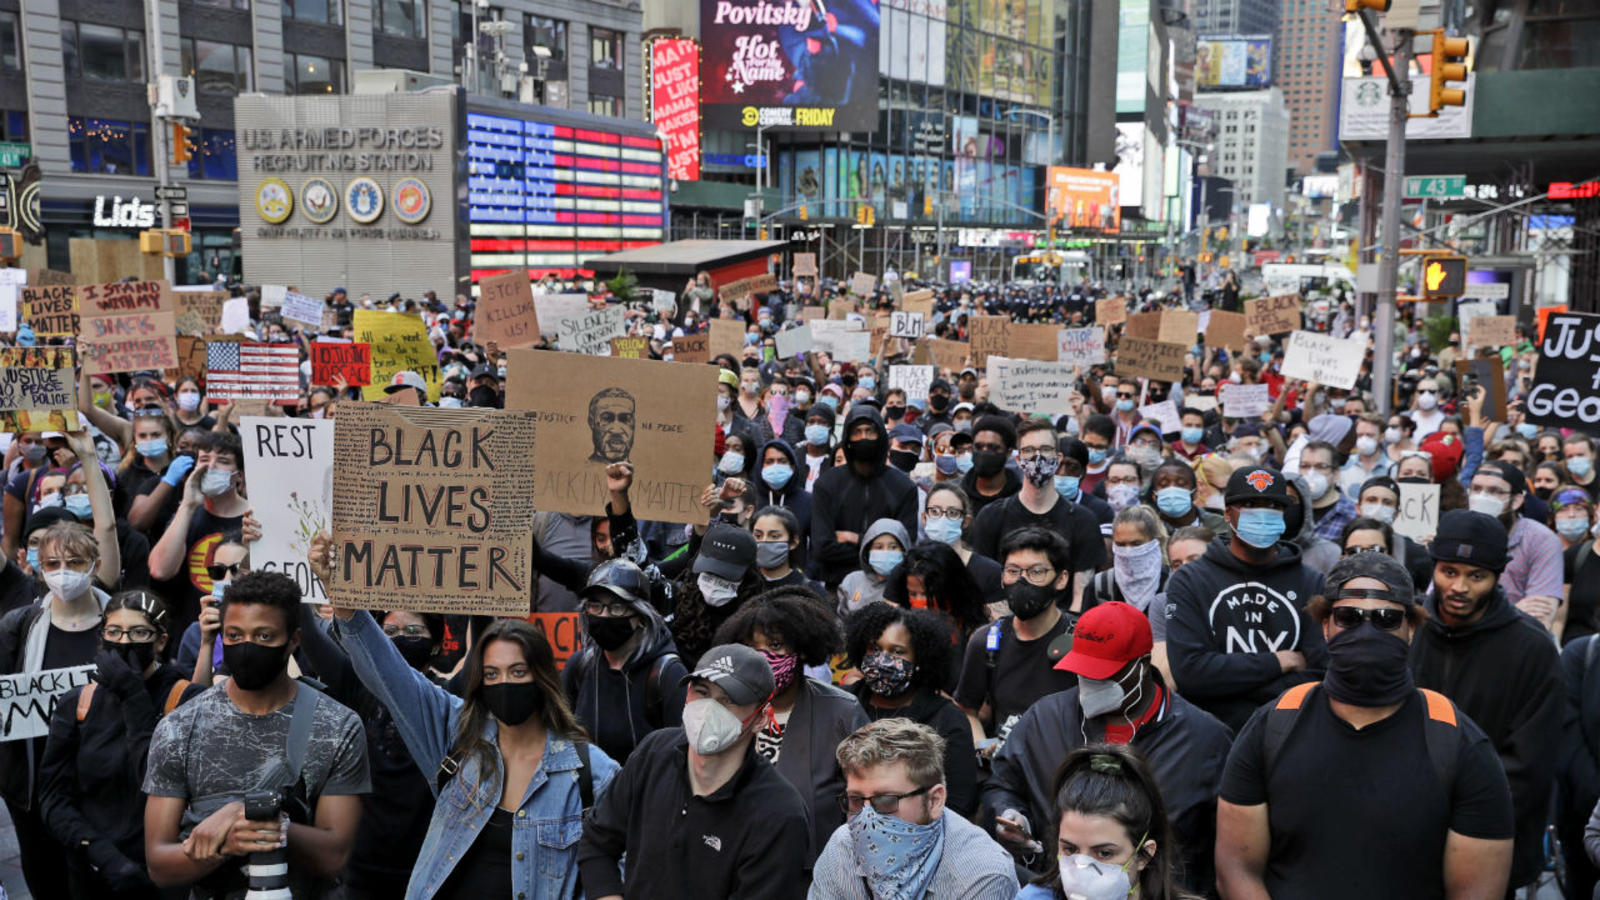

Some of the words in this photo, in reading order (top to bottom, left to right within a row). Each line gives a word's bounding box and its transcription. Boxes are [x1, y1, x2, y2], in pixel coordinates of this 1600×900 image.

[714, 0, 812, 32] Povitsky
[733, 34, 779, 61] Hot
[654, 62, 691, 89] JUST
[733, 60, 785, 85] Name
[654, 96, 695, 120] MAMA
[759, 107, 792, 116] COMEDY
[759, 116, 793, 125] CENTRAL
[796, 108, 835, 125] FRIDAY
[243, 129, 276, 150] U.S.
[280, 127, 355, 149] ARMED
[358, 126, 443, 148] FORCES
[253, 154, 355, 172] RECRUITING
[358, 153, 434, 171] STATION
[669, 146, 699, 170] UST
[1408, 180, 1423, 195] W
[1426, 179, 1446, 195] 43
[1453, 178, 1463, 188] ST
[93, 195, 155, 227] Lids
[23, 286, 74, 303] BLACK
[83, 285, 98, 300] I
[103, 281, 160, 298] STAND
[487, 281, 522, 300] STOP
[31, 298, 72, 315] LIVES
[96, 295, 135, 310] WITH
[137, 293, 160, 310] MY
[1256, 297, 1297, 311] BLACK
[486, 301, 535, 322] KILLING
[28, 313, 81, 335] MATTER
[91, 315, 155, 337] BLACK
[561, 308, 611, 336] SILENCE
[896, 314, 922, 334] BLM
[969, 320, 1010, 336] BLACK
[361, 331, 373, 342] All
[574, 322, 618, 345] CONSENT
[1066, 329, 1092, 341] STOP
[614, 340, 645, 350] YELLOW
[674, 340, 707, 353] BLACK
[970, 337, 1008, 350] LIVES
[1125, 340, 1182, 357] JUSTICE
[3, 368, 58, 385] JUSTICE
[896, 366, 927, 379] BLACK
[998, 366, 1008, 378] I
[21, 382, 63, 396] PEACE
[242, 383, 252, 397] IN
[896, 379, 928, 390] LIVES
[32, 393, 70, 408] POLICE
[538, 411, 578, 423] JUSTICE
[657, 423, 684, 434] PEACE
[256, 424, 316, 459] REST
[369, 427, 496, 471] BLACK
[378, 481, 491, 533] LIVES
[337, 524, 360, 533] George
[364, 525, 381, 536] Floyd
[343, 541, 523, 592] MATTER
[1226, 592, 1280, 613] MADE
[1244, 611, 1263, 623] IN
[1226, 625, 1289, 654] NY
[710, 659, 735, 673] adidas
[0, 672, 64, 699] BLACK
